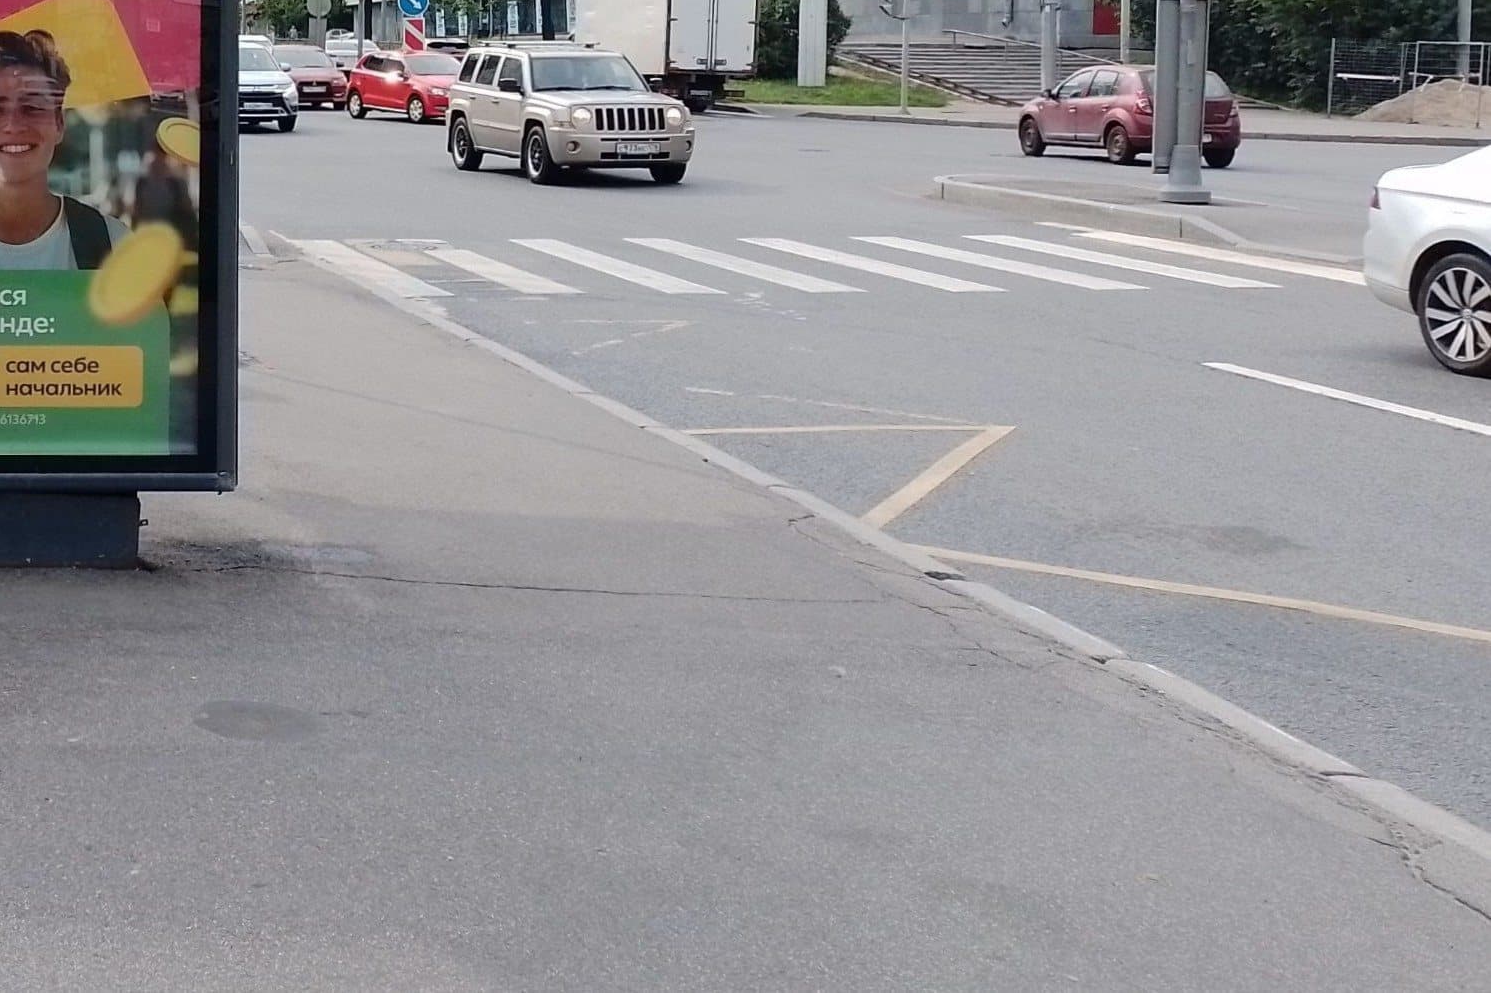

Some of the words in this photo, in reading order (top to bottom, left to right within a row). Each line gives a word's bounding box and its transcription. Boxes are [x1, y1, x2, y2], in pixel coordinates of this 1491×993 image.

[5, 360, 47, 374] сам
[50, 356, 100, 374] себе
[5, 382, 123, 397] начальник
